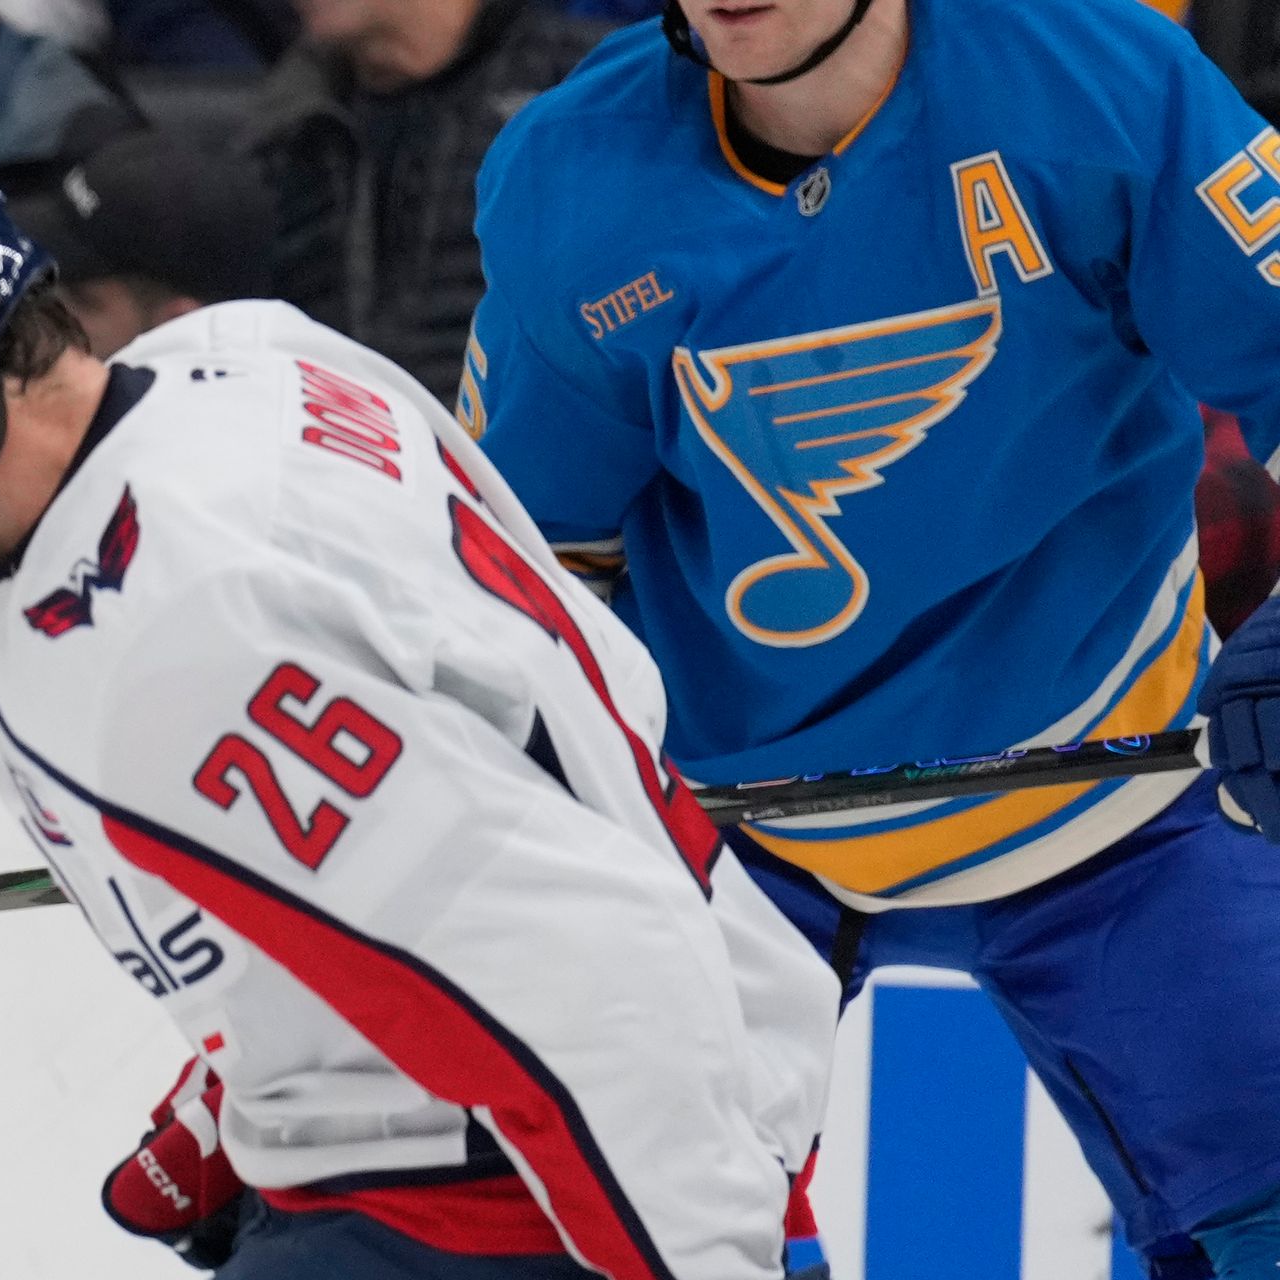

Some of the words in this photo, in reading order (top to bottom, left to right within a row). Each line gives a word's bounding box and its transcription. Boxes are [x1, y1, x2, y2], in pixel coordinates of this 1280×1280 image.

[950, 151, 1054, 299] A
[580, 270, 674, 341] STIFEL
[192, 660, 405, 874] 26
[137, 1147, 192, 1213] CCM
